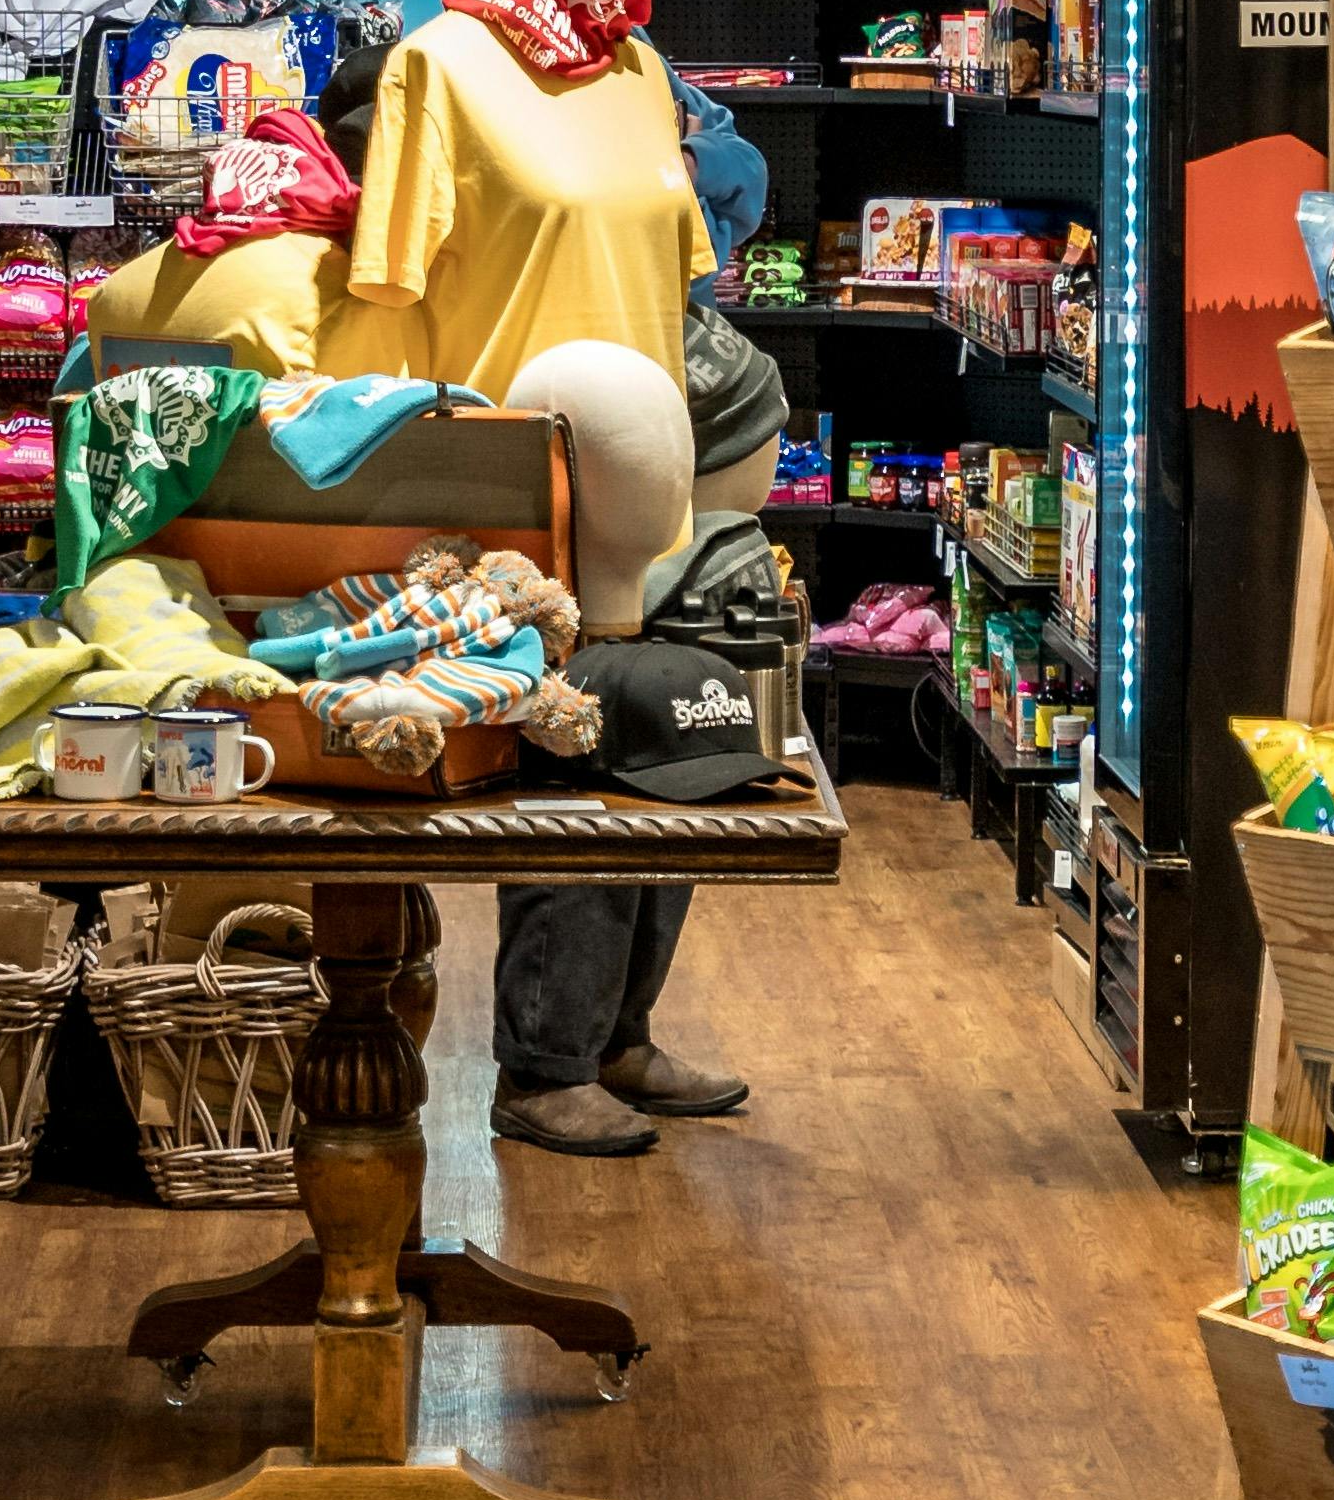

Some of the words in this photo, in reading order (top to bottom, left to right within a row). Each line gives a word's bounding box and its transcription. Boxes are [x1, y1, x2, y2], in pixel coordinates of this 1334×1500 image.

[515, 5, 542, 31] OUR
[13, 448, 50, 459] WHITE
[79, 444, 123, 479] THE
[92, 482, 113, 496] FOR
[674, 694, 754, 730] general
